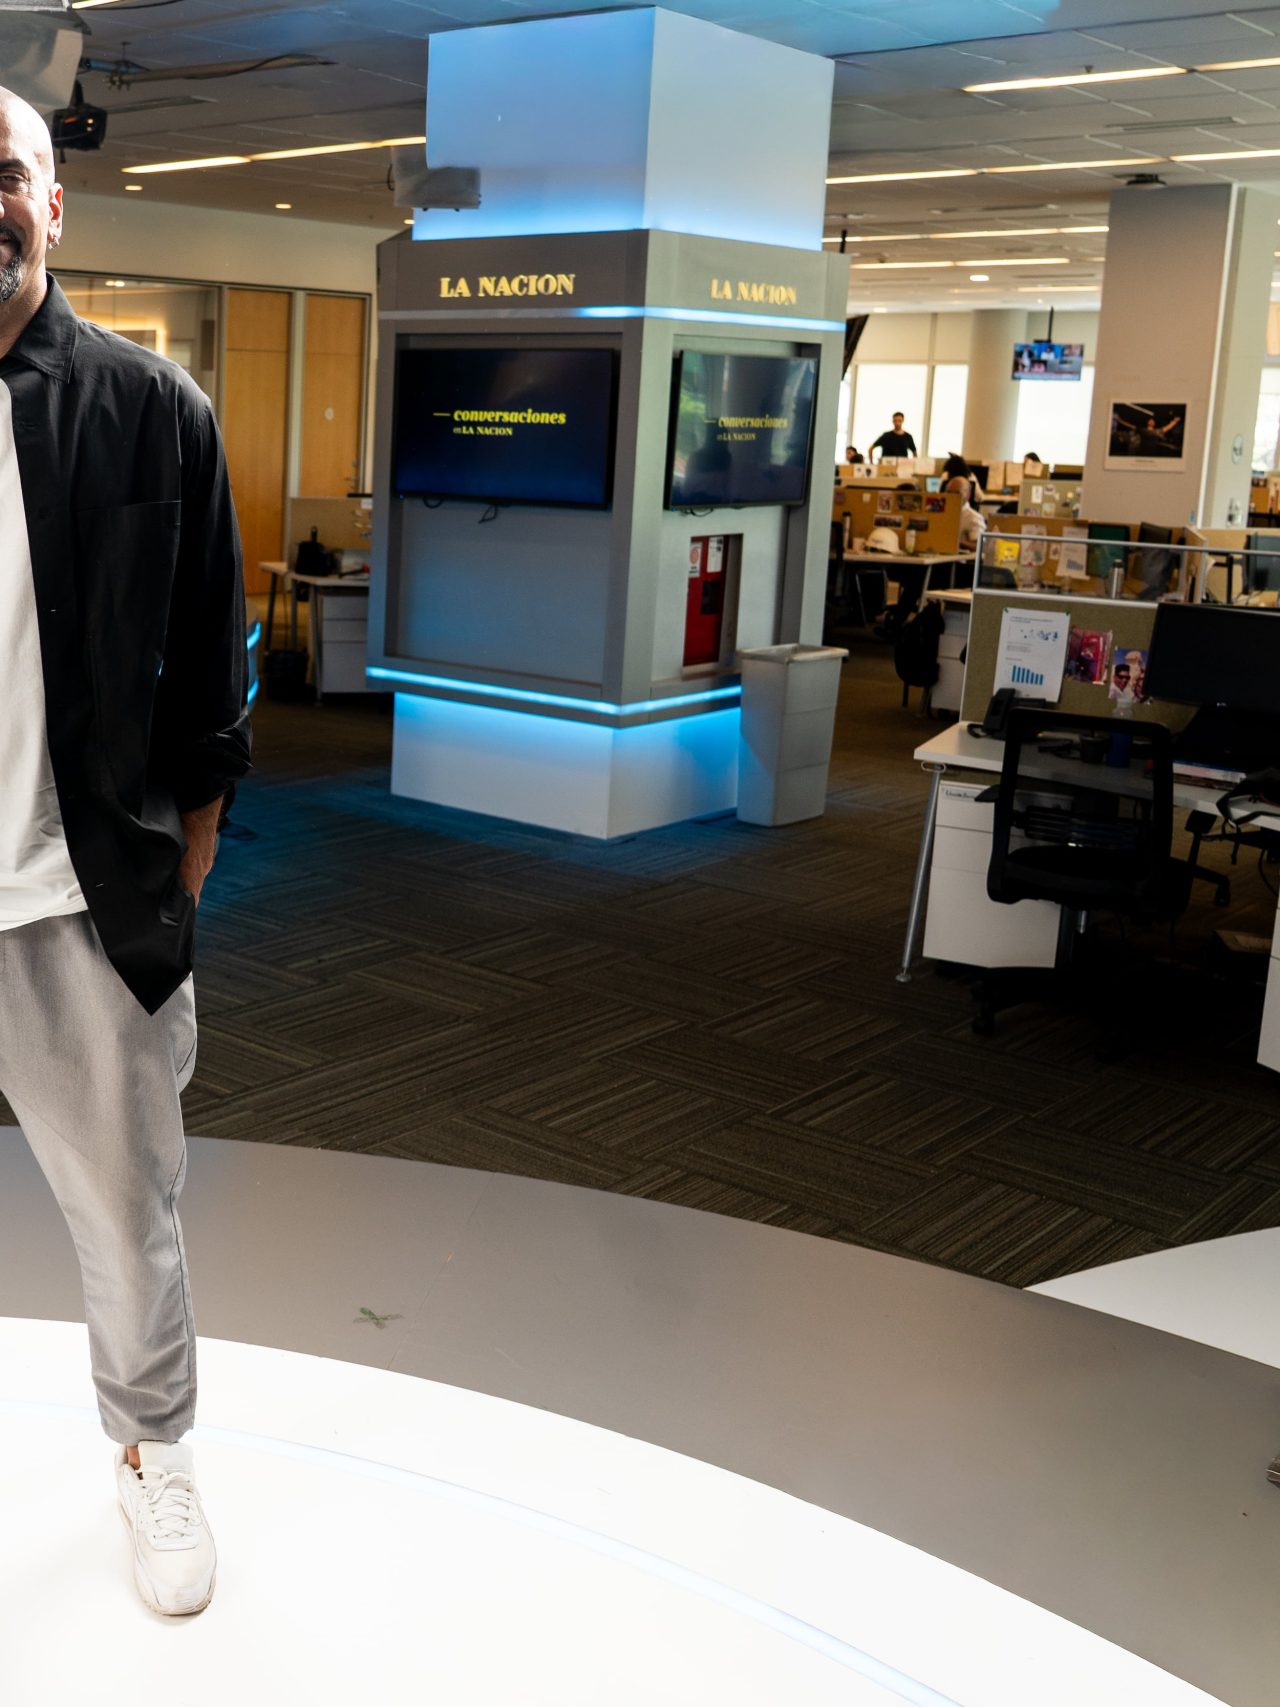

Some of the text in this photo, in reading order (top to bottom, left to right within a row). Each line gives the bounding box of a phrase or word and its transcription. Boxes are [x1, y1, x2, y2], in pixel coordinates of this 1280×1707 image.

[439, 273, 576, 298] LA NACION
[710, 278, 798, 307] LA NACION
[453, 408, 567, 425] conversaciones
[719, 414, 788, 428] conversaciones
[462, 425, 475, 435] LA
[476, 426, 514, 436] NACION
